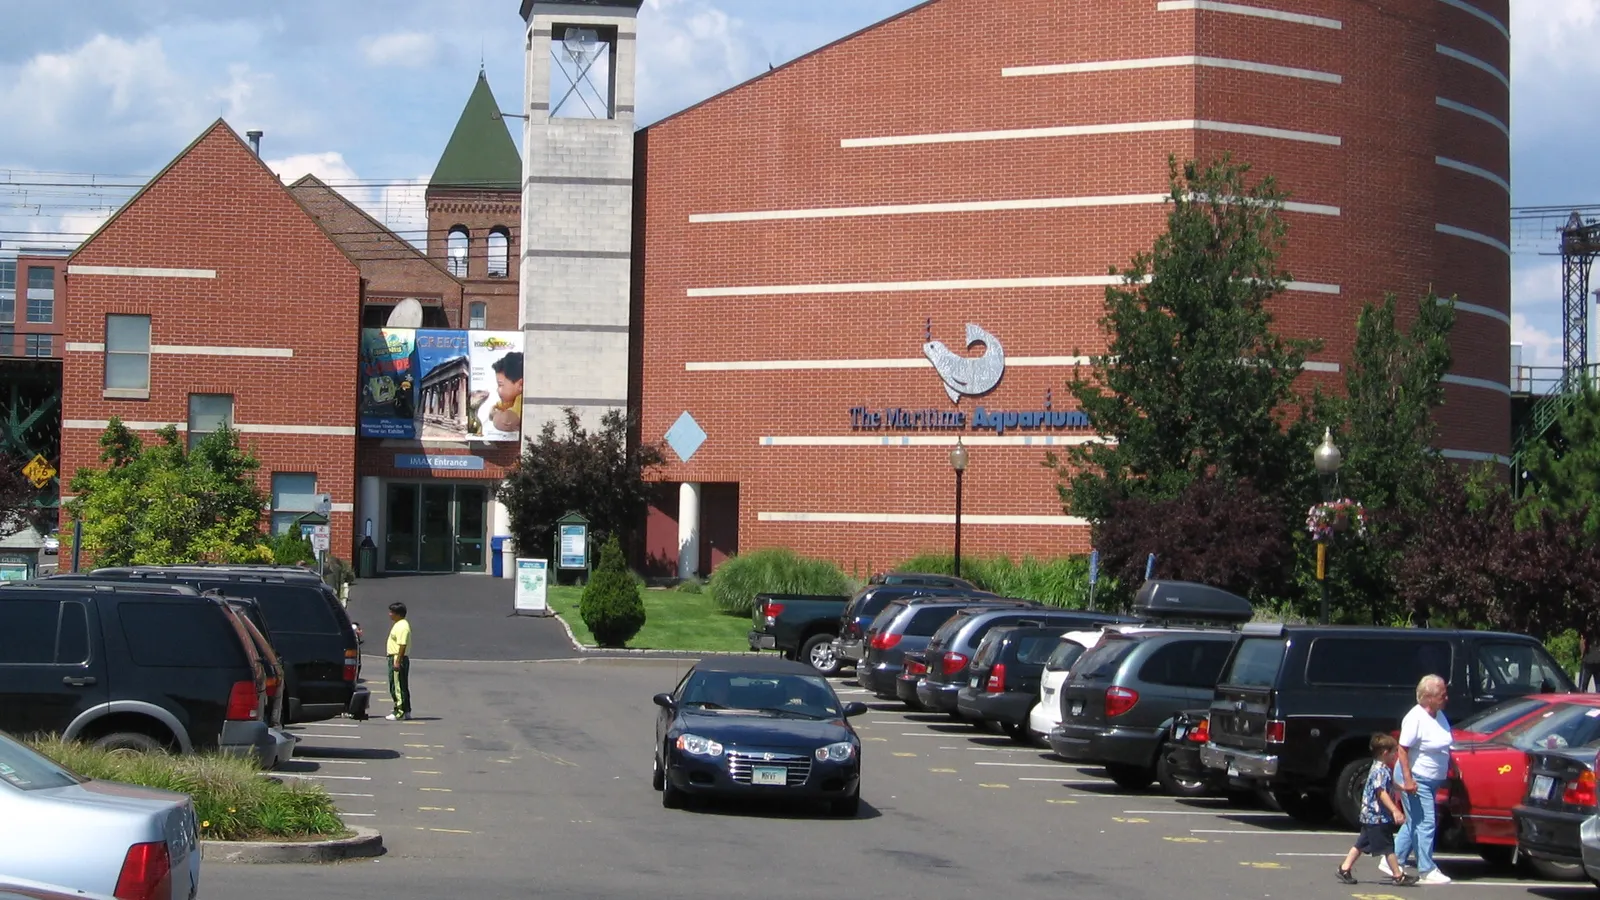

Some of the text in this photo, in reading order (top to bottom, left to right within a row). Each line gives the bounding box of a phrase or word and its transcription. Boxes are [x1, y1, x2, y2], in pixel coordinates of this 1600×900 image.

[416, 335, 467, 348] GREECE
[850, 407, 1088, 434] The Maritime Aquarium
[410, 457, 468, 467] IMAX Entrance
